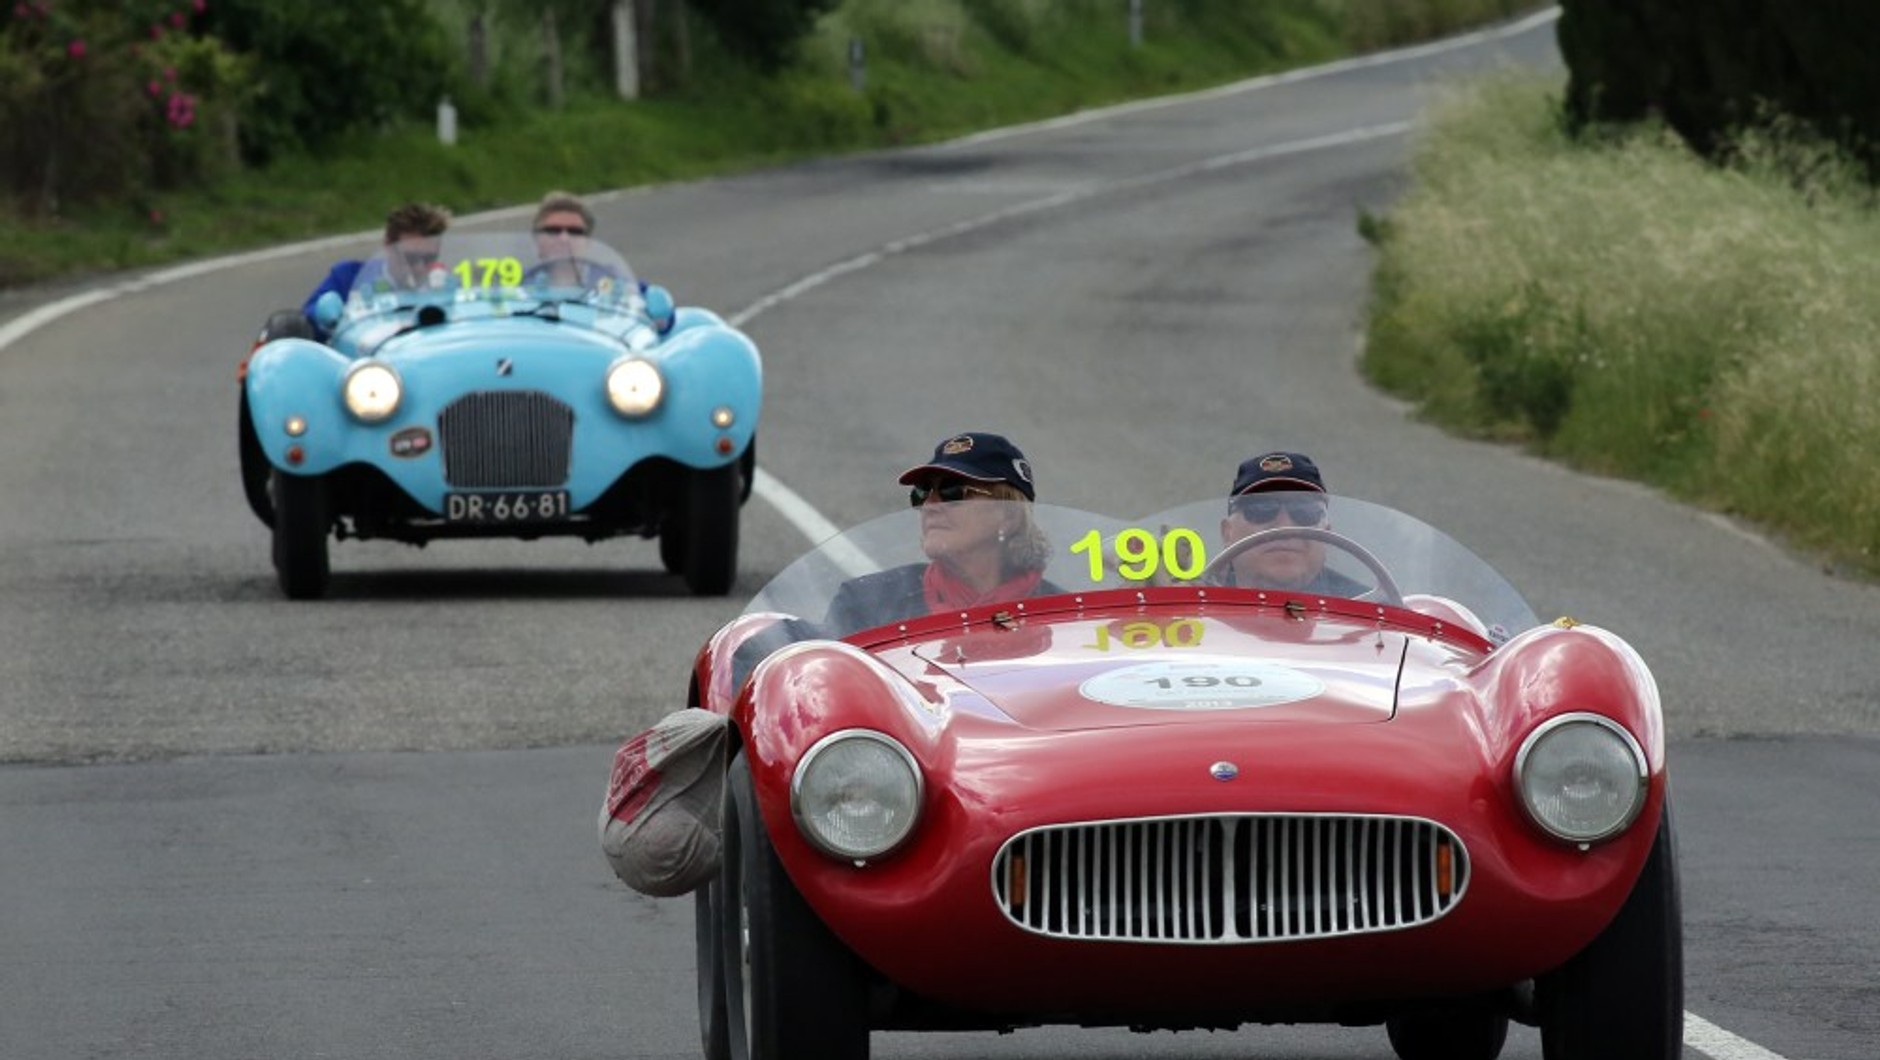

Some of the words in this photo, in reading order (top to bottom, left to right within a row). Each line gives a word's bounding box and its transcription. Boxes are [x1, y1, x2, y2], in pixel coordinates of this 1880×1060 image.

[454, 256, 523, 289] 179
[1070, 528, 1207, 582] 190
[1144, 675, 1263, 689] 190
